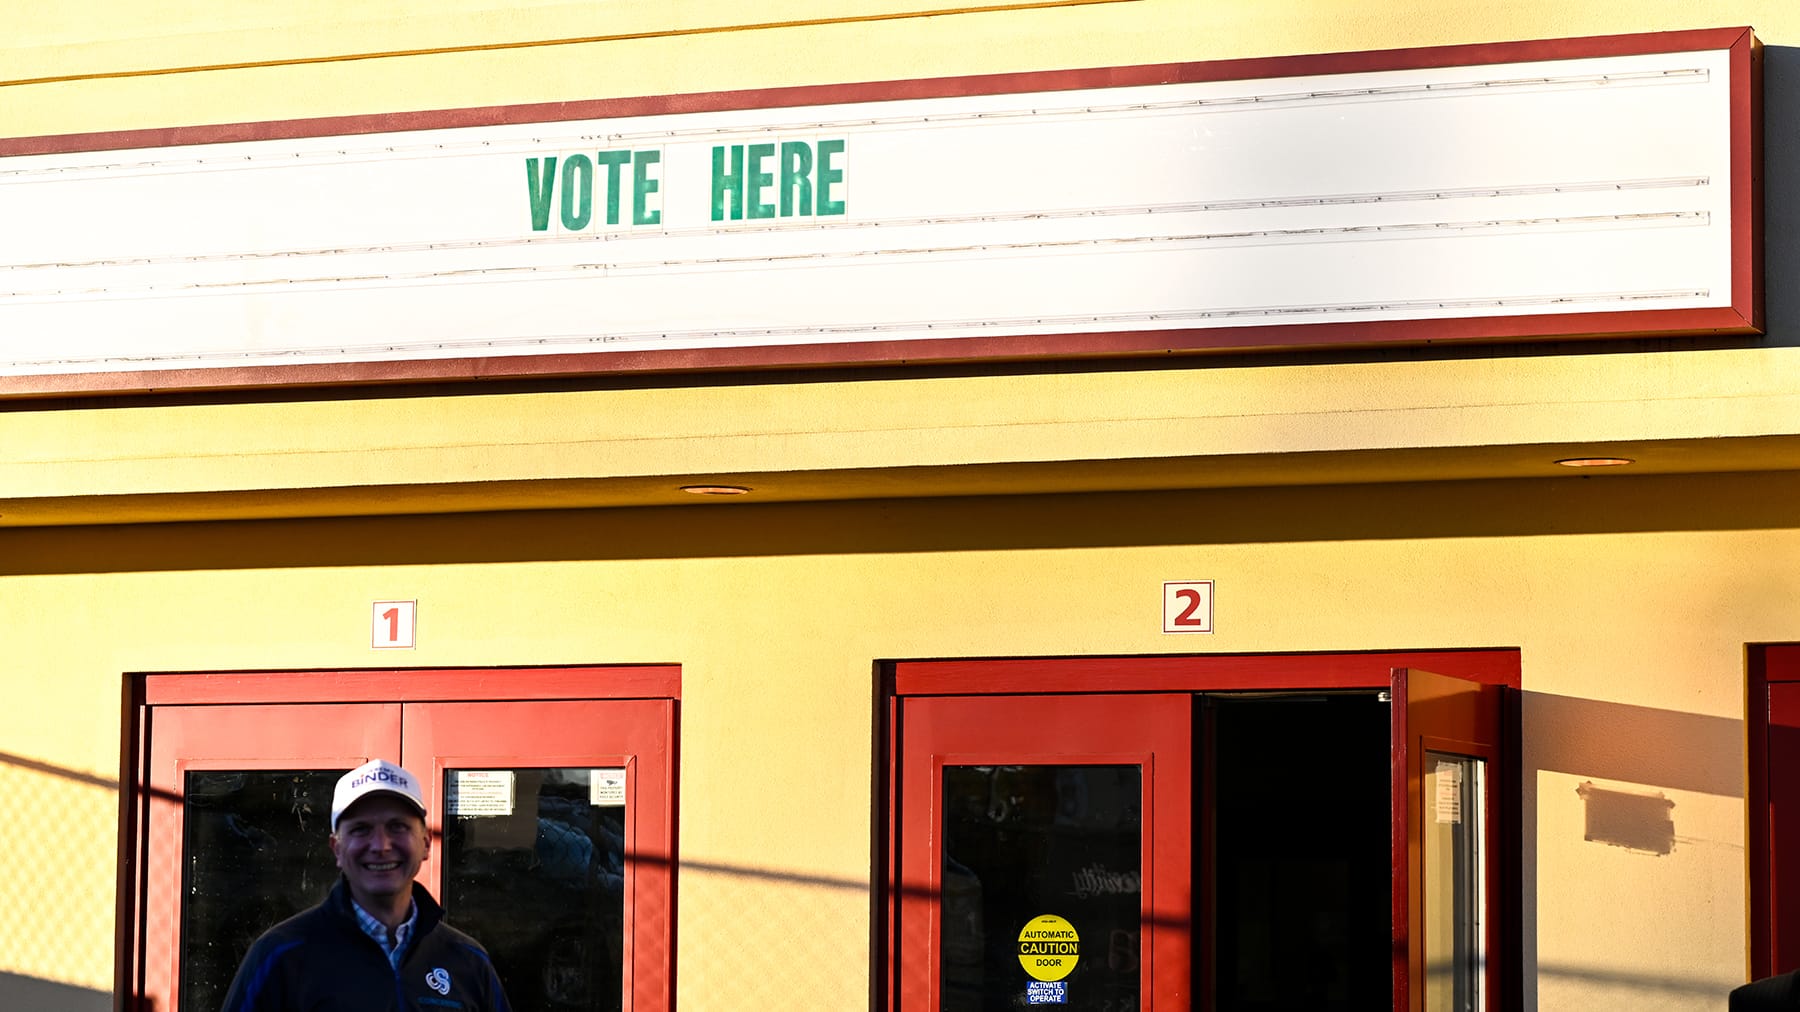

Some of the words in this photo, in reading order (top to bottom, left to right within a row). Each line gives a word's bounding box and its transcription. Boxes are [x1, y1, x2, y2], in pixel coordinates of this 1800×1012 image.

[526, 150, 661, 231] VOTE
[711, 139, 845, 221] HERE
[1174, 589, 1201, 626] 2
[382, 607, 399, 641] 1
[1024, 930, 1074, 939] AUTOMATIC
[1020, 942, 1078, 954] CAUTION
[1036, 958, 1062, 967] DOOR
